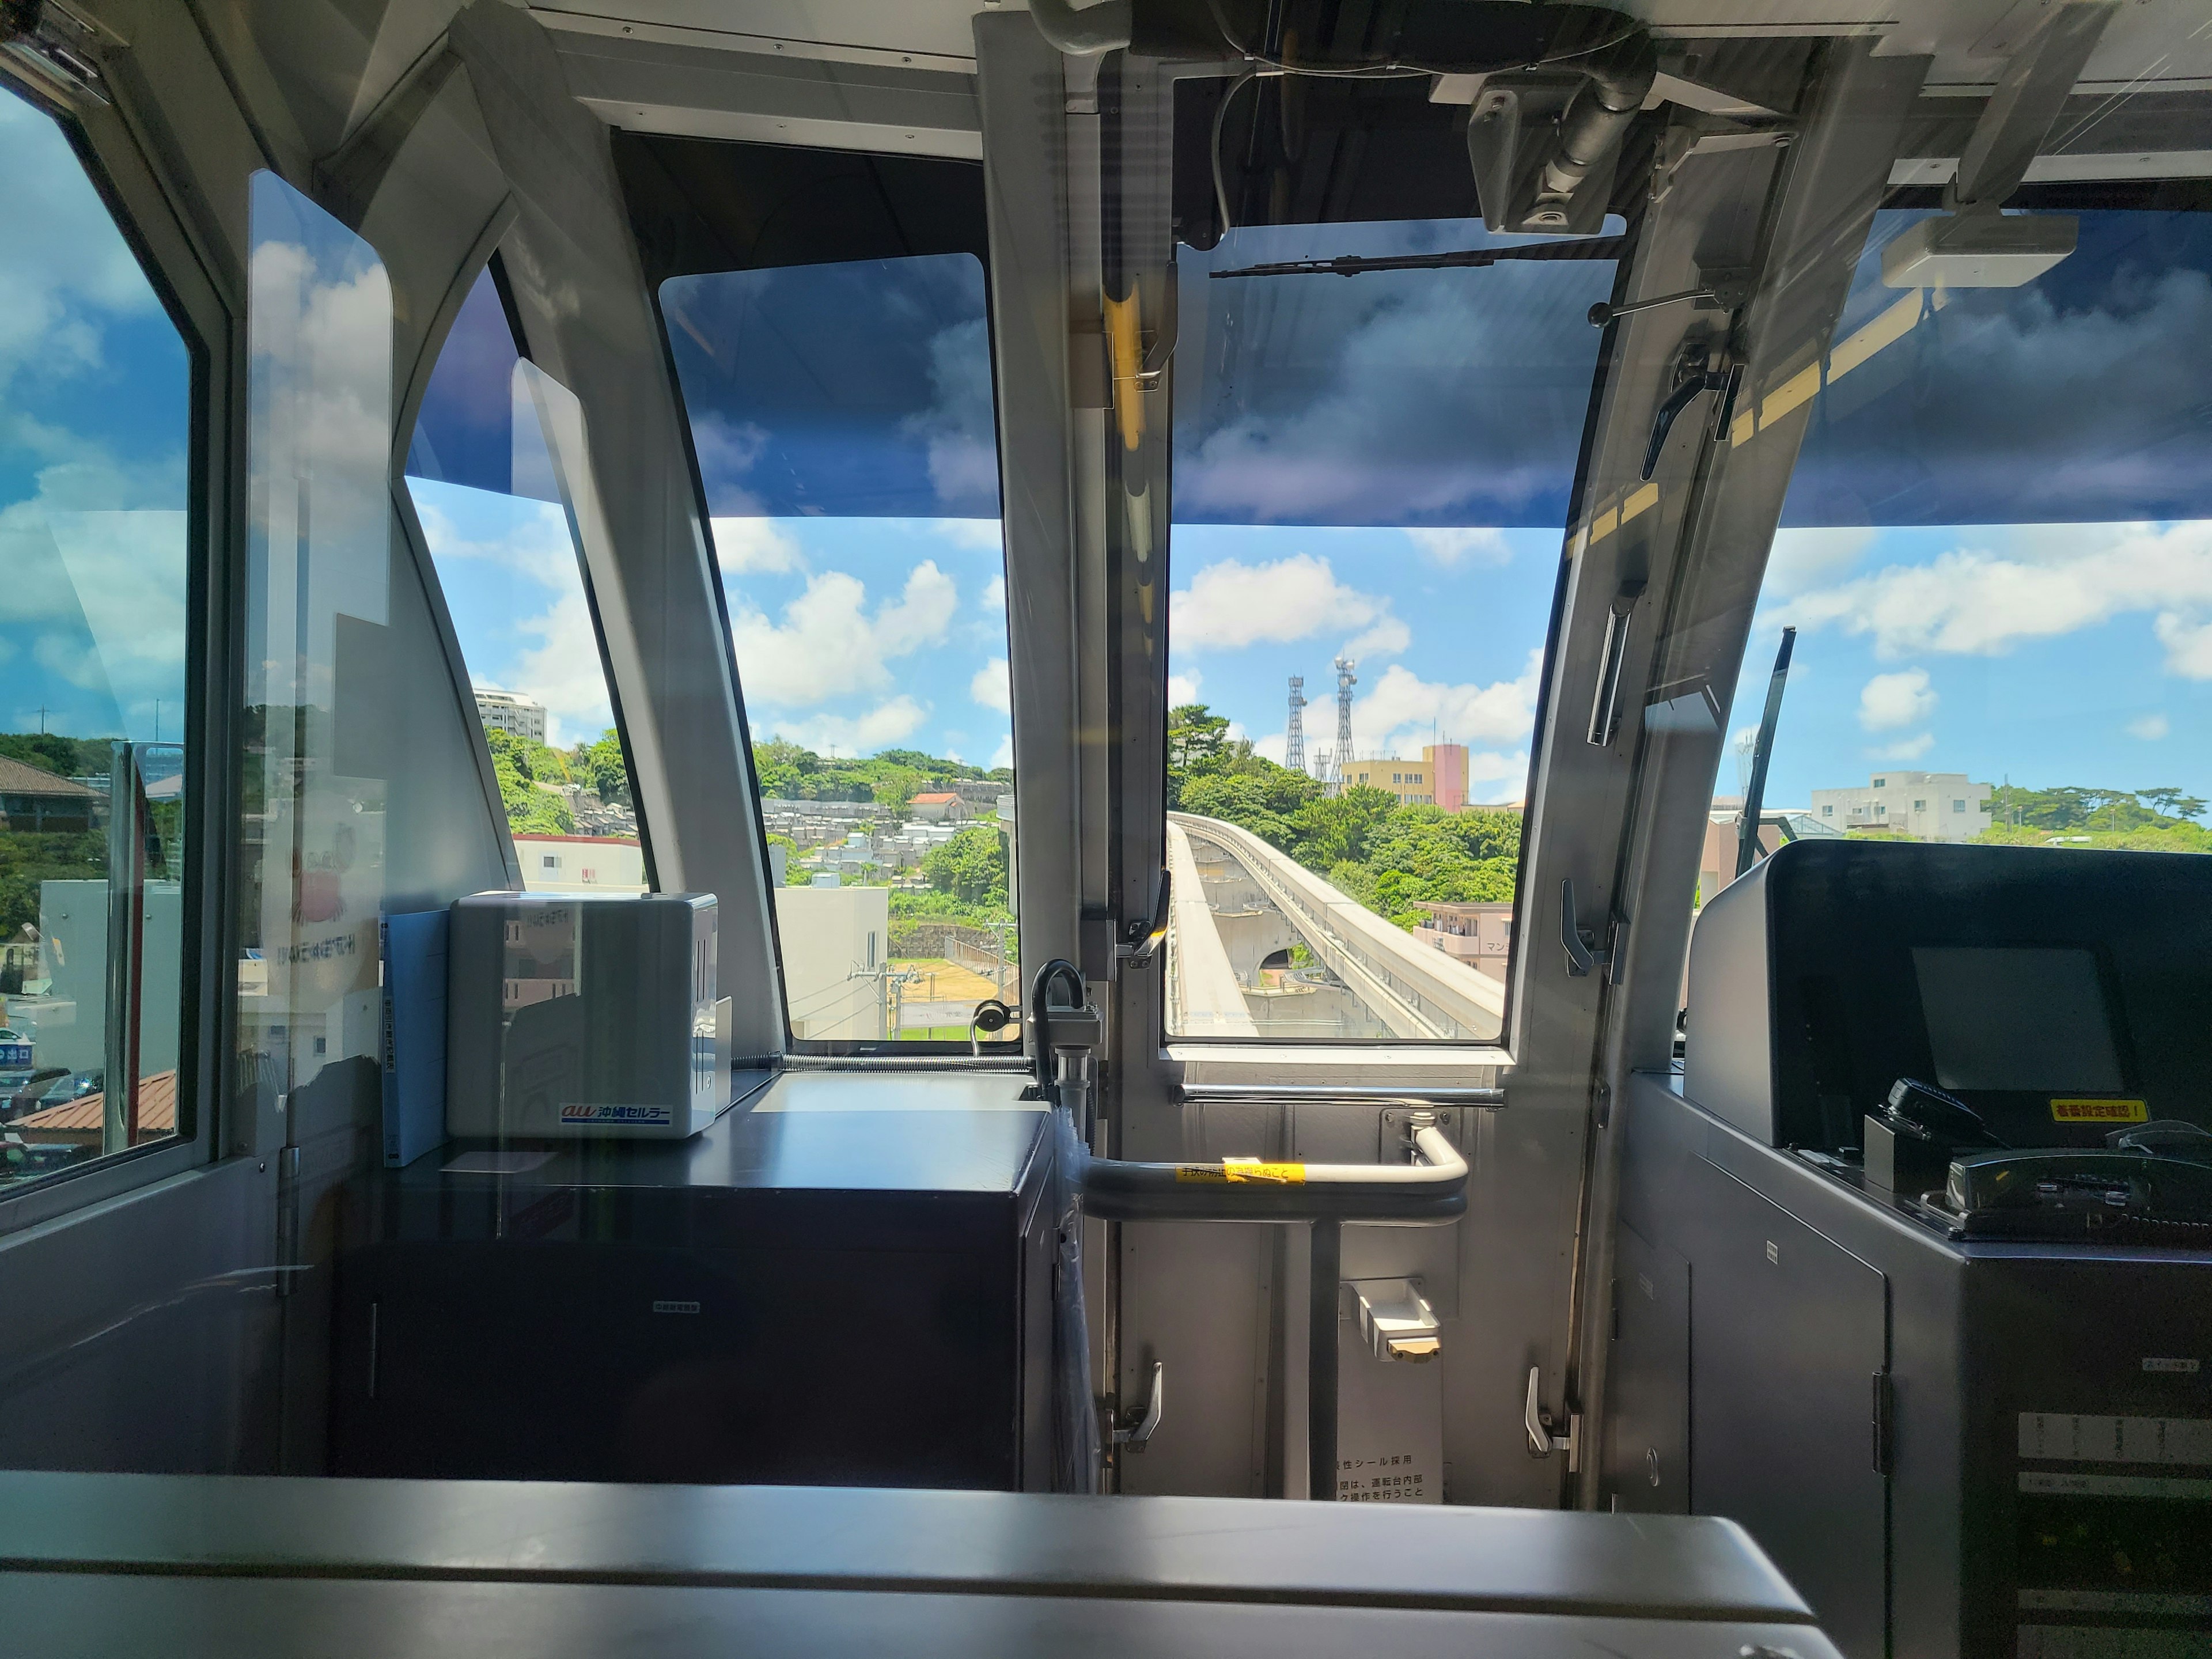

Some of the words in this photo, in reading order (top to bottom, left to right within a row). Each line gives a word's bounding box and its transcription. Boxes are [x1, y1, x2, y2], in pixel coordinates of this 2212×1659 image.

[1487, 942, 1509, 952] マン
[562, 1105, 596, 1117] au
[597, 1105, 671, 1118] 沖縄セルラー
